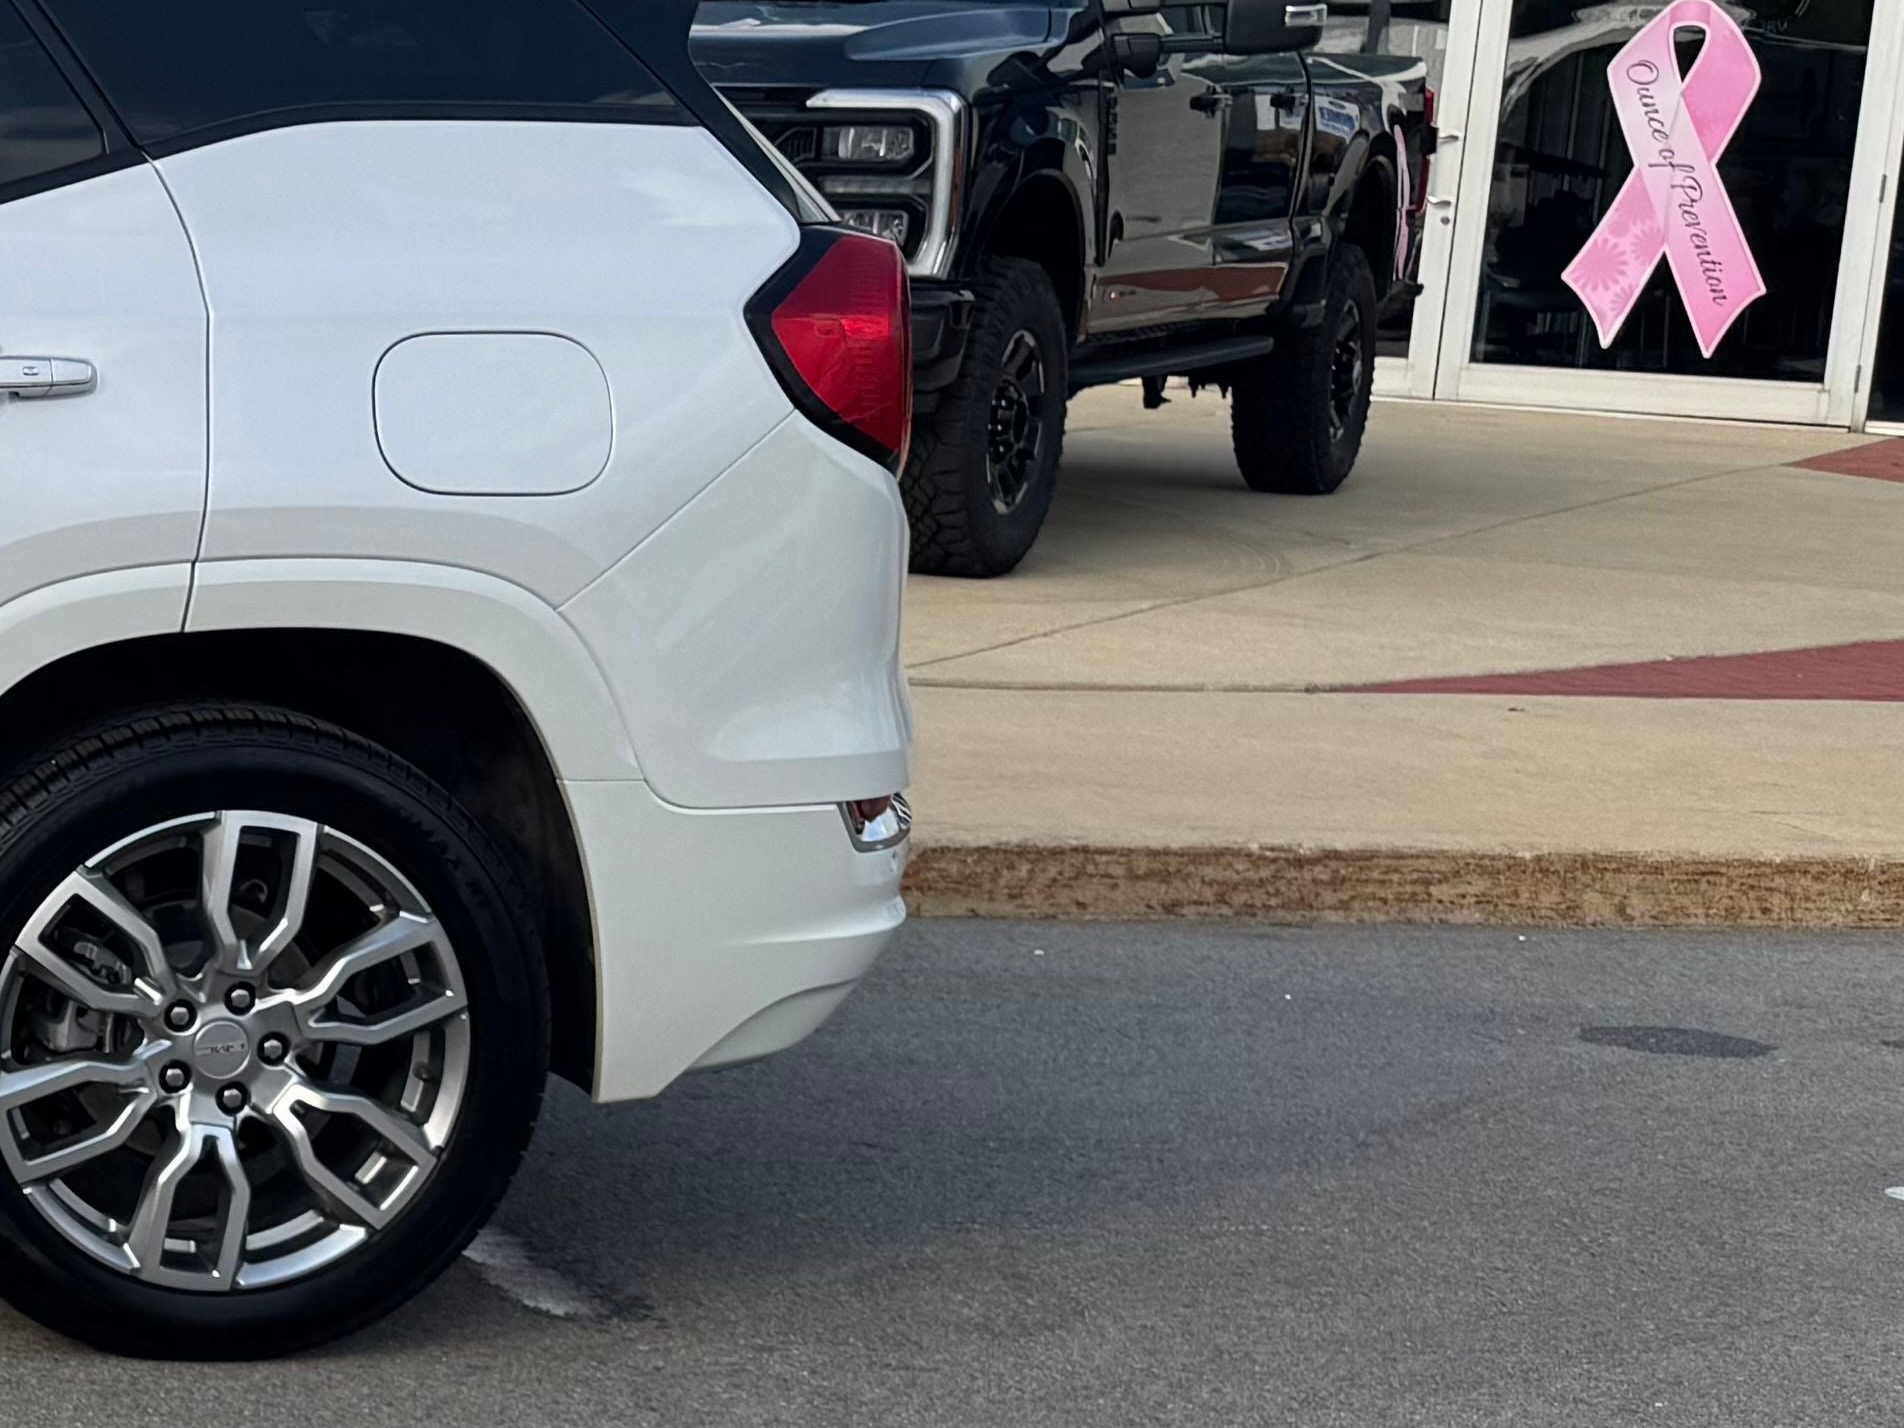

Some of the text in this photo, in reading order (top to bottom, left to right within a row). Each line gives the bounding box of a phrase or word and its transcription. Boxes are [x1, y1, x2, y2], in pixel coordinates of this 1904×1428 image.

[1626, 59, 1728, 307] Ounce of Prevention
